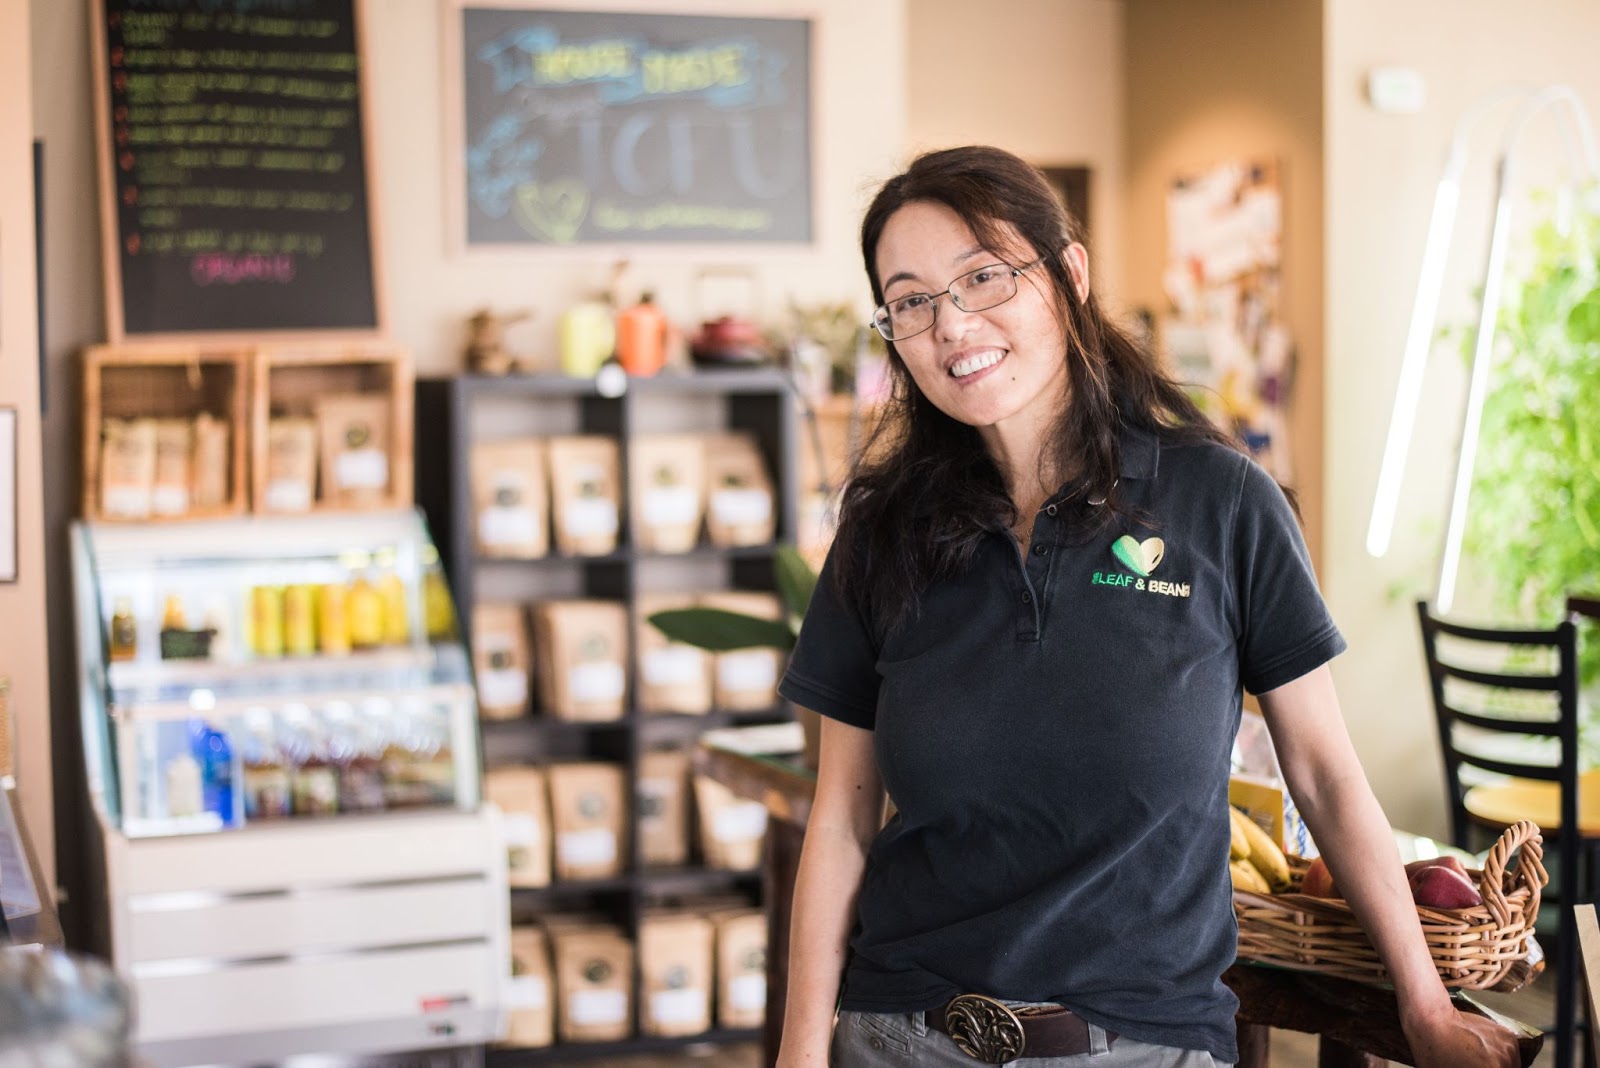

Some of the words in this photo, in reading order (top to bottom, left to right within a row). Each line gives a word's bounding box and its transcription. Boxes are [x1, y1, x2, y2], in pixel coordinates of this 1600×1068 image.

[1098, 571, 1134, 587] LEAF
[1135, 578, 1145, 591] &
[1148, 580, 1184, 597] BEAN
